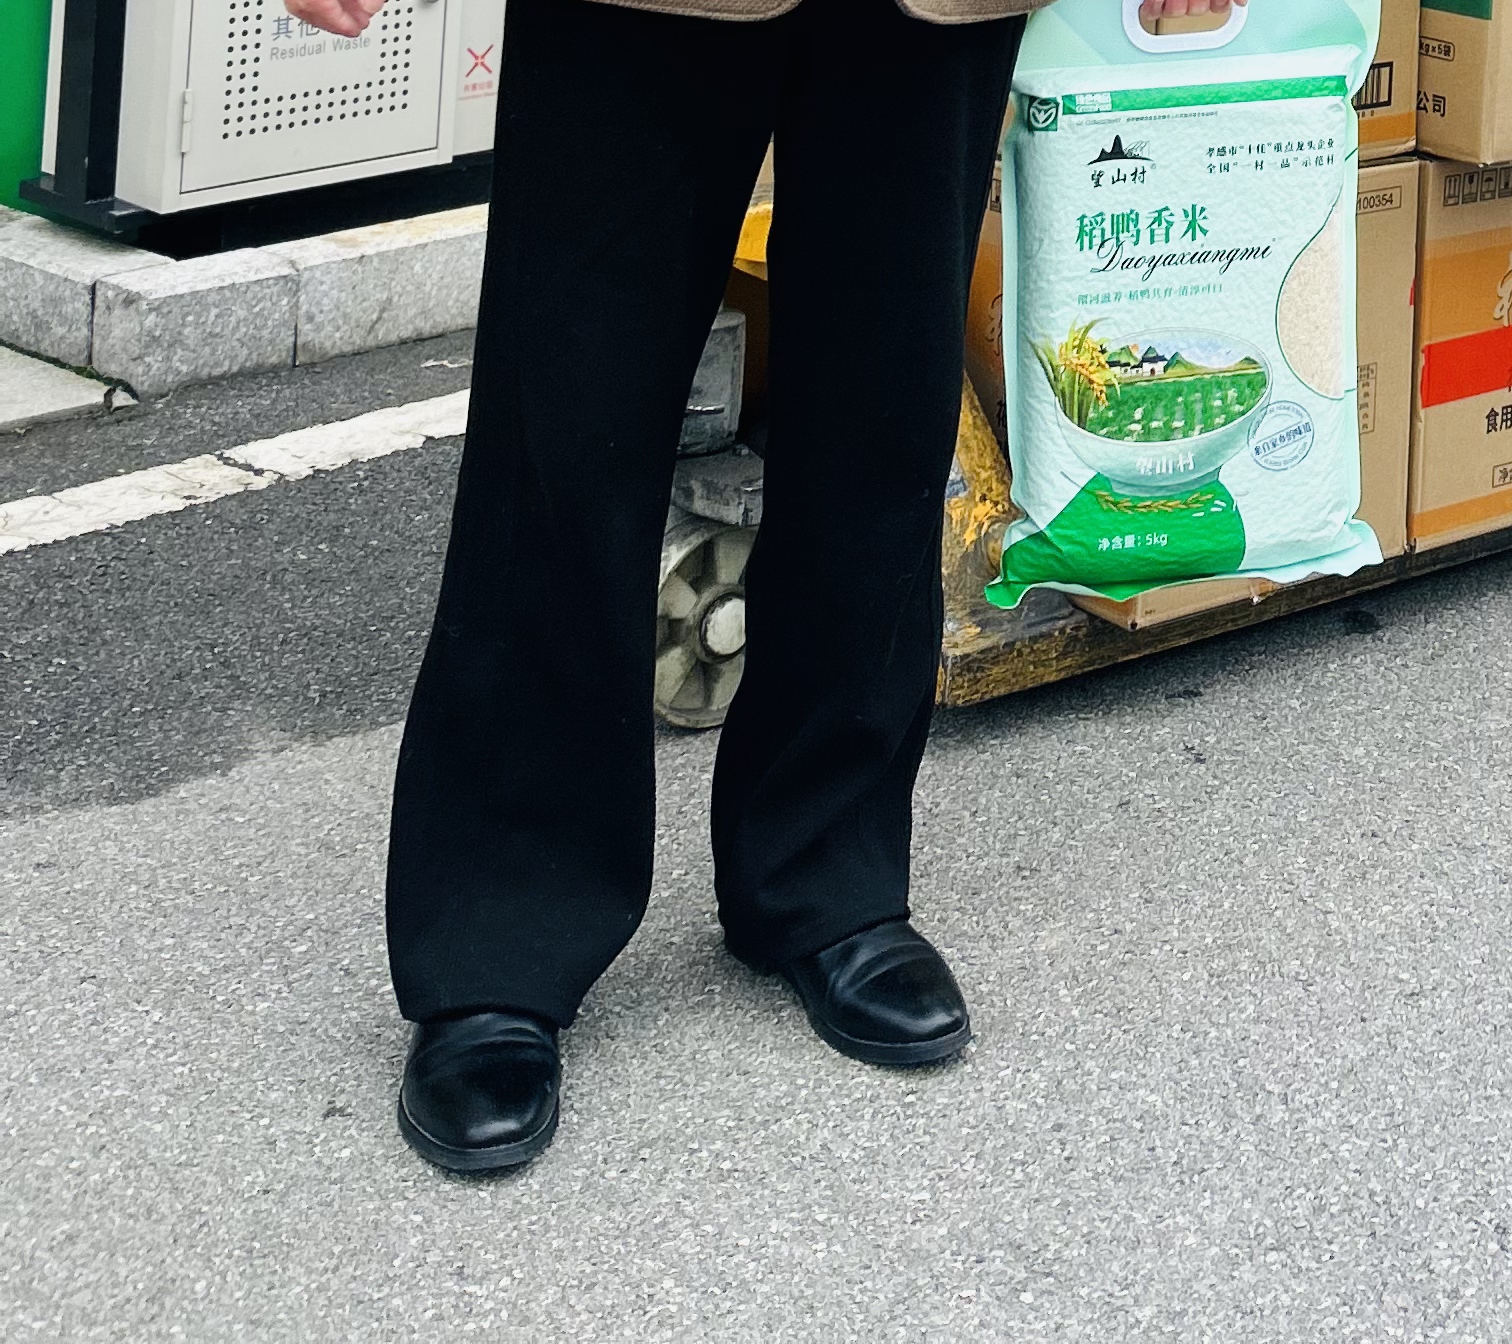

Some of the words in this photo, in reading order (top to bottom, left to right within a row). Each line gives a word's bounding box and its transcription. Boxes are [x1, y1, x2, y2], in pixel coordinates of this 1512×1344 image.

[270, 41, 327, 62] Residual
[332, 36, 372, 53] Waste
[1074, 203, 1209, 252] 稻鸭香米
[1089, 237, 1276, 282] Daoyaxiangmi
